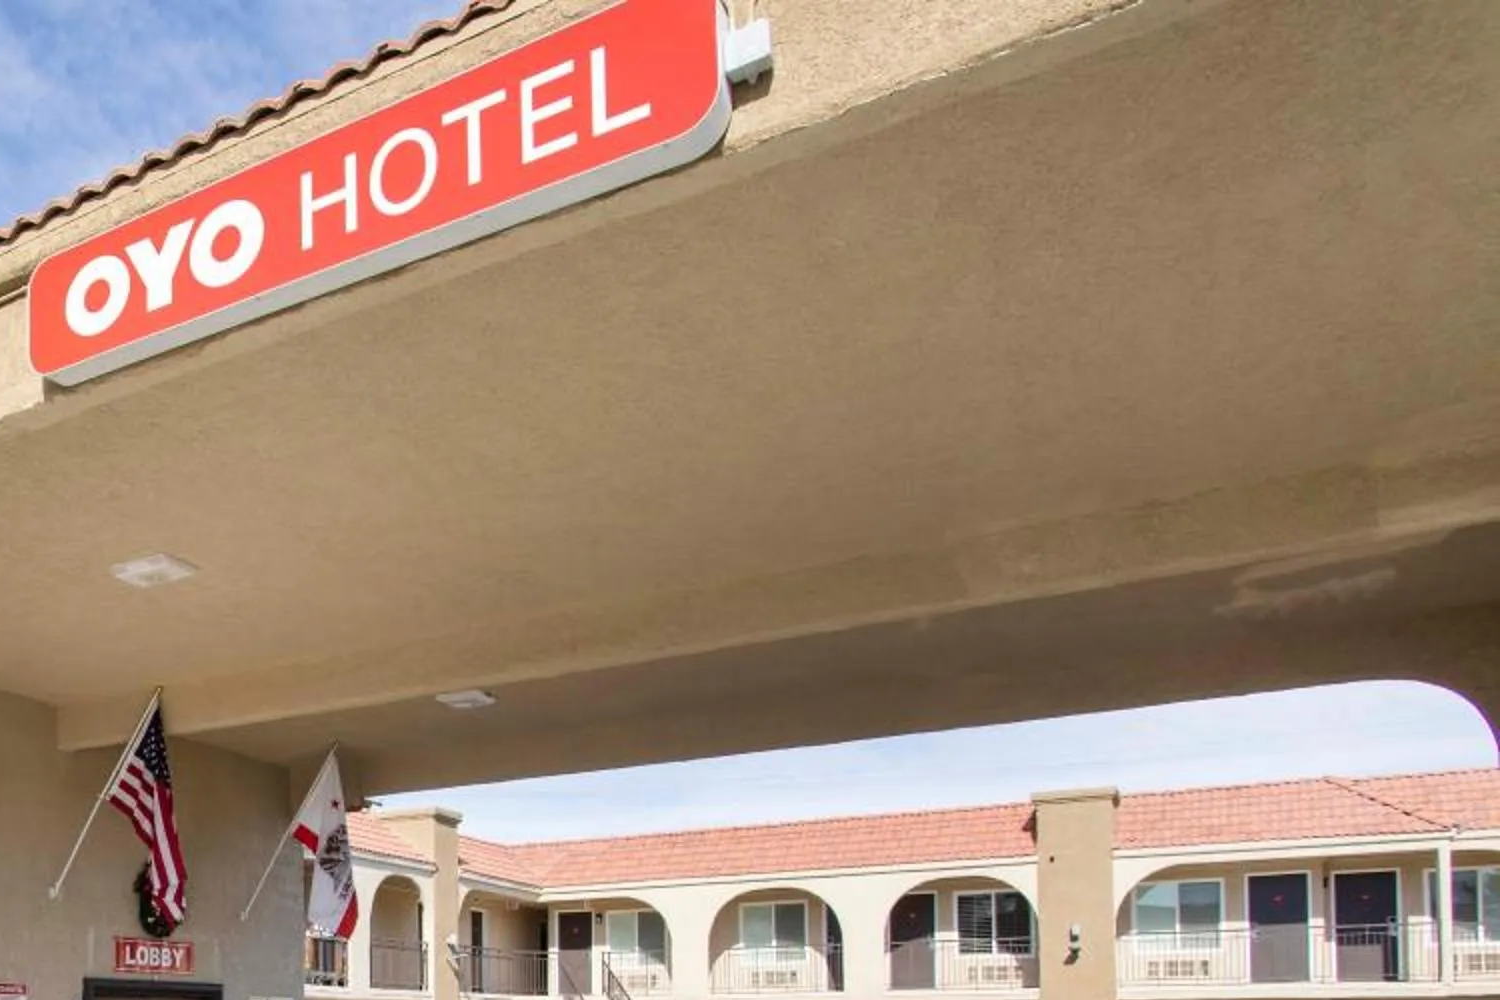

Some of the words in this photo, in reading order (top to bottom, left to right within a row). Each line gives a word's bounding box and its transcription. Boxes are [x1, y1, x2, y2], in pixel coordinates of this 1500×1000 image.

[65, 199, 264, 337] OYO
[300, 46, 651, 249] HOTEL
[125, 945, 184, 969] LOBBY
